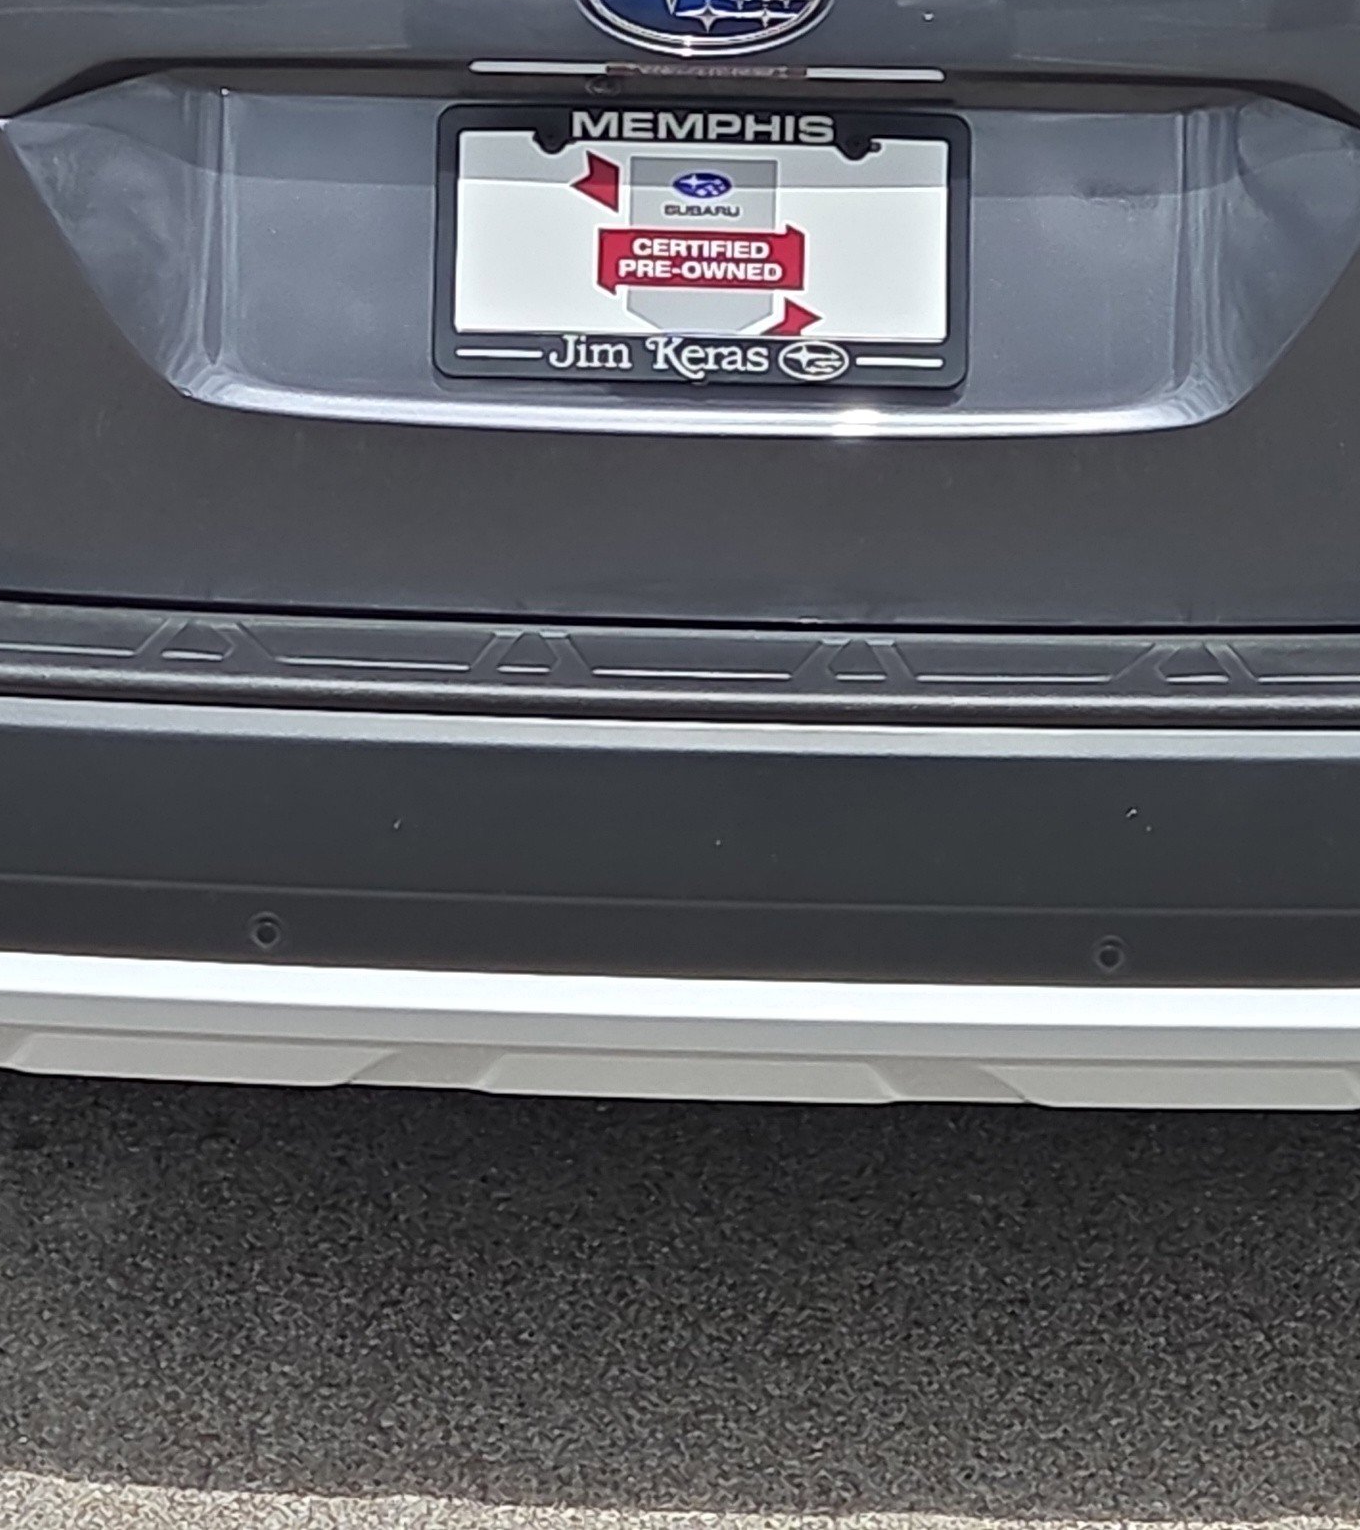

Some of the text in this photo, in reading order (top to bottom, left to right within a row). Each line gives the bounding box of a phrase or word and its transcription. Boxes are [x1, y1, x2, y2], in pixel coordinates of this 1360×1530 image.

[571, 111, 835, 142] MEMPHIS
[663, 203, 740, 217] SUBARU
[632, 237, 770, 259] CERTIFIED
[618, 259, 783, 282] PRE-OWNED
[548, 334, 769, 378] Jim Keras
